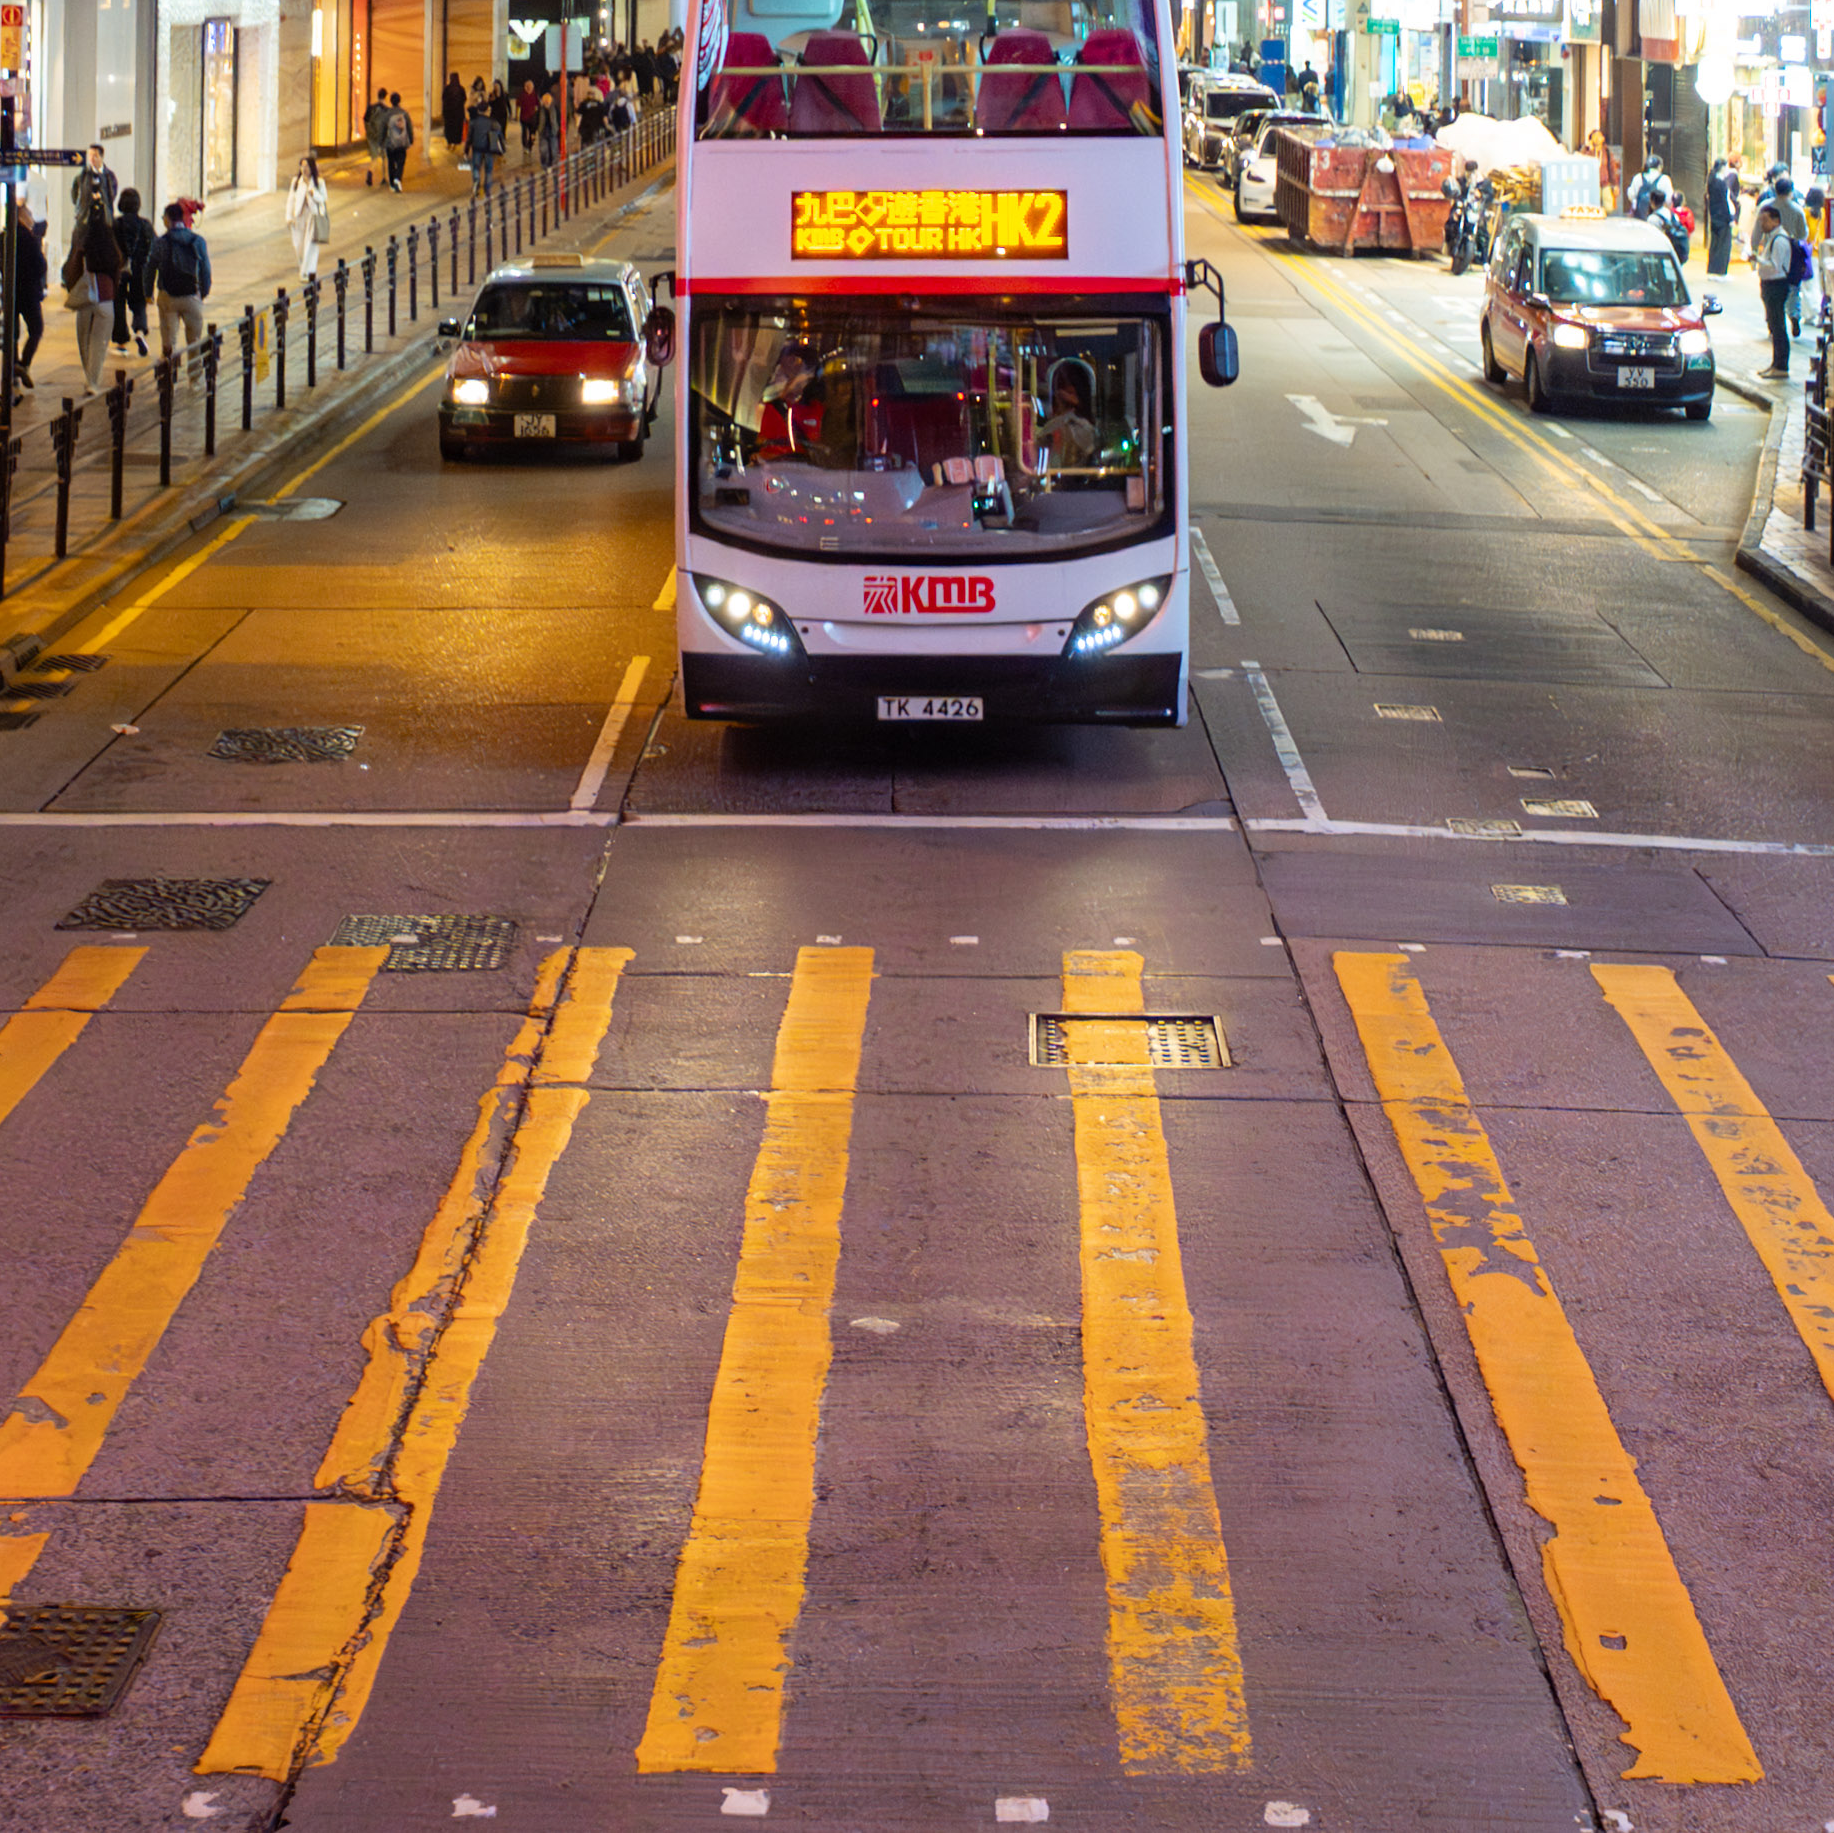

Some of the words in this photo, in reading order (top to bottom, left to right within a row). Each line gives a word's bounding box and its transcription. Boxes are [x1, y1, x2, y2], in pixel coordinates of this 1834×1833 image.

[795, 191, 857, 226] 九巴
[886, 191, 981, 226] 遊香港
[981, 192, 1063, 246] HK2
[796, 227, 846, 251] KMB
[874, 227, 944, 250] TOUR
[948, 227, 982, 250] HK
[901, 576, 996, 614] KMB
[883, 698, 910, 718] TK
[922, 698, 980, 718] 4426
